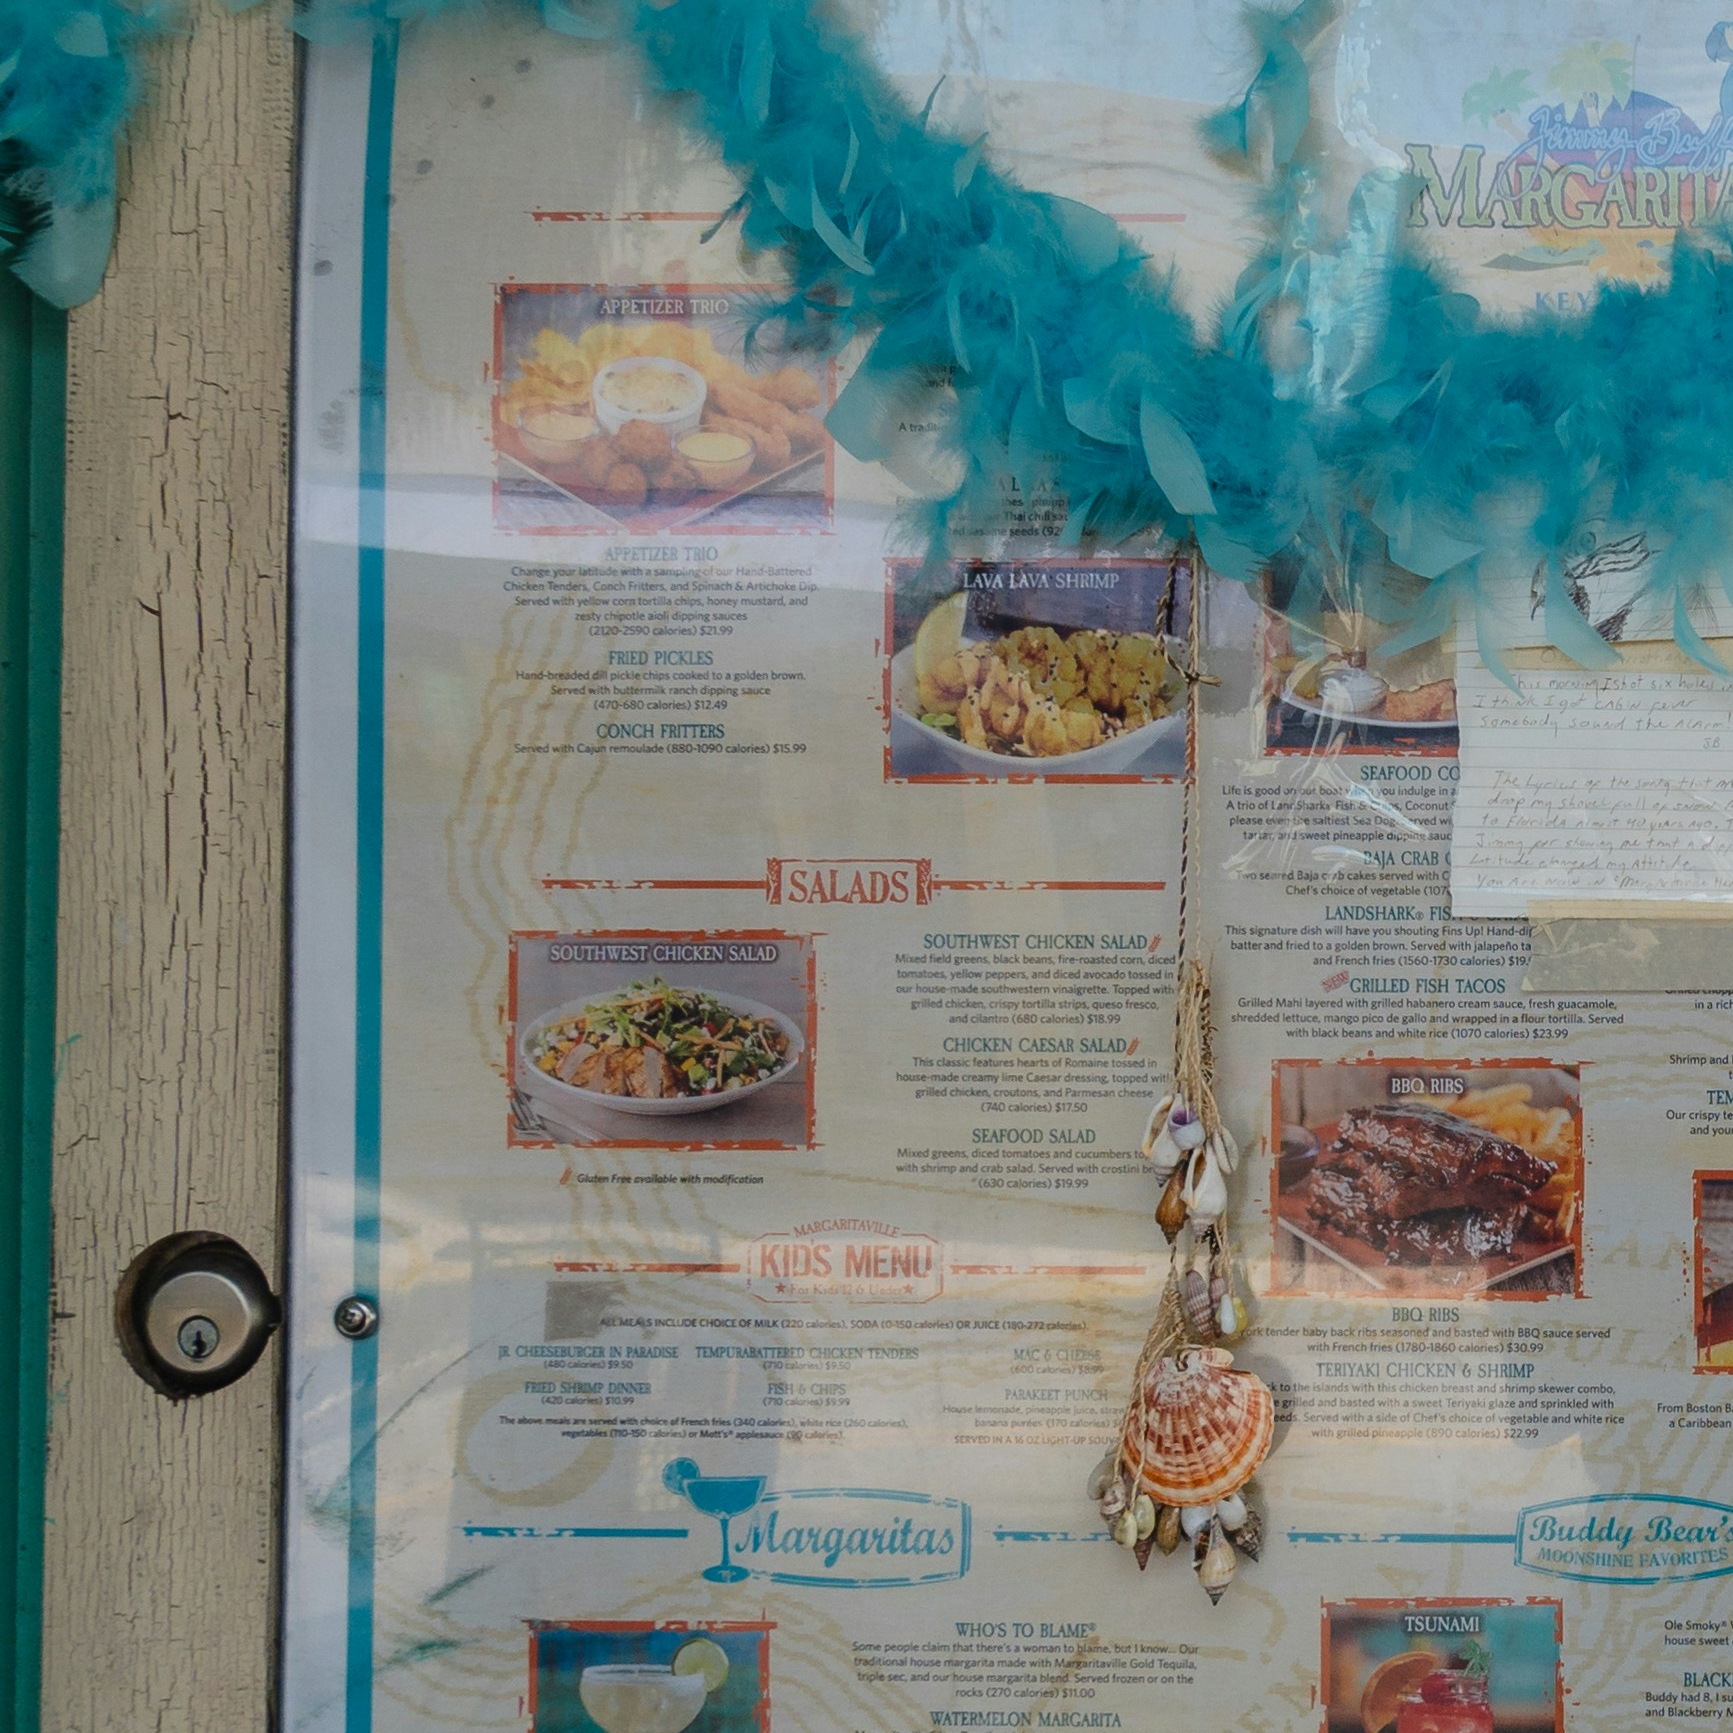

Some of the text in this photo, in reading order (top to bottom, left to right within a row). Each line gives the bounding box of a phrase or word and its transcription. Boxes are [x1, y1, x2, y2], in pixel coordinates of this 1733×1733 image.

[1497, 105, 1638, 200] Jimmy
[600, 296, 728, 316] APPETIZER TRIO
[1534, 290, 1593, 313] KEY
[964, 571, 1119, 592] LAVA LAVA SHRIMP
[608, 650, 713, 665] FRIED PICKLES
[596, 724, 724, 741] CONCH FRITTERS
[788, 869, 908, 904] SALADS
[550, 942, 777, 964] SOUTHWEST CHICKEN SALAD
[1392, 1078, 1463, 1093] BBQ RIBS
[793, 1218, 900, 1239] MARGARITAVILLE
[845, 1246, 932, 1278] MENU
[736, 1508, 954, 1569] Margaritas
[1530, 1512, 1635, 1550] Buddy
[1538, 1546, 1728, 1570] MOONSHINE FAVORITES
[1405, 1616, 1479, 1631] TSUNAMI
